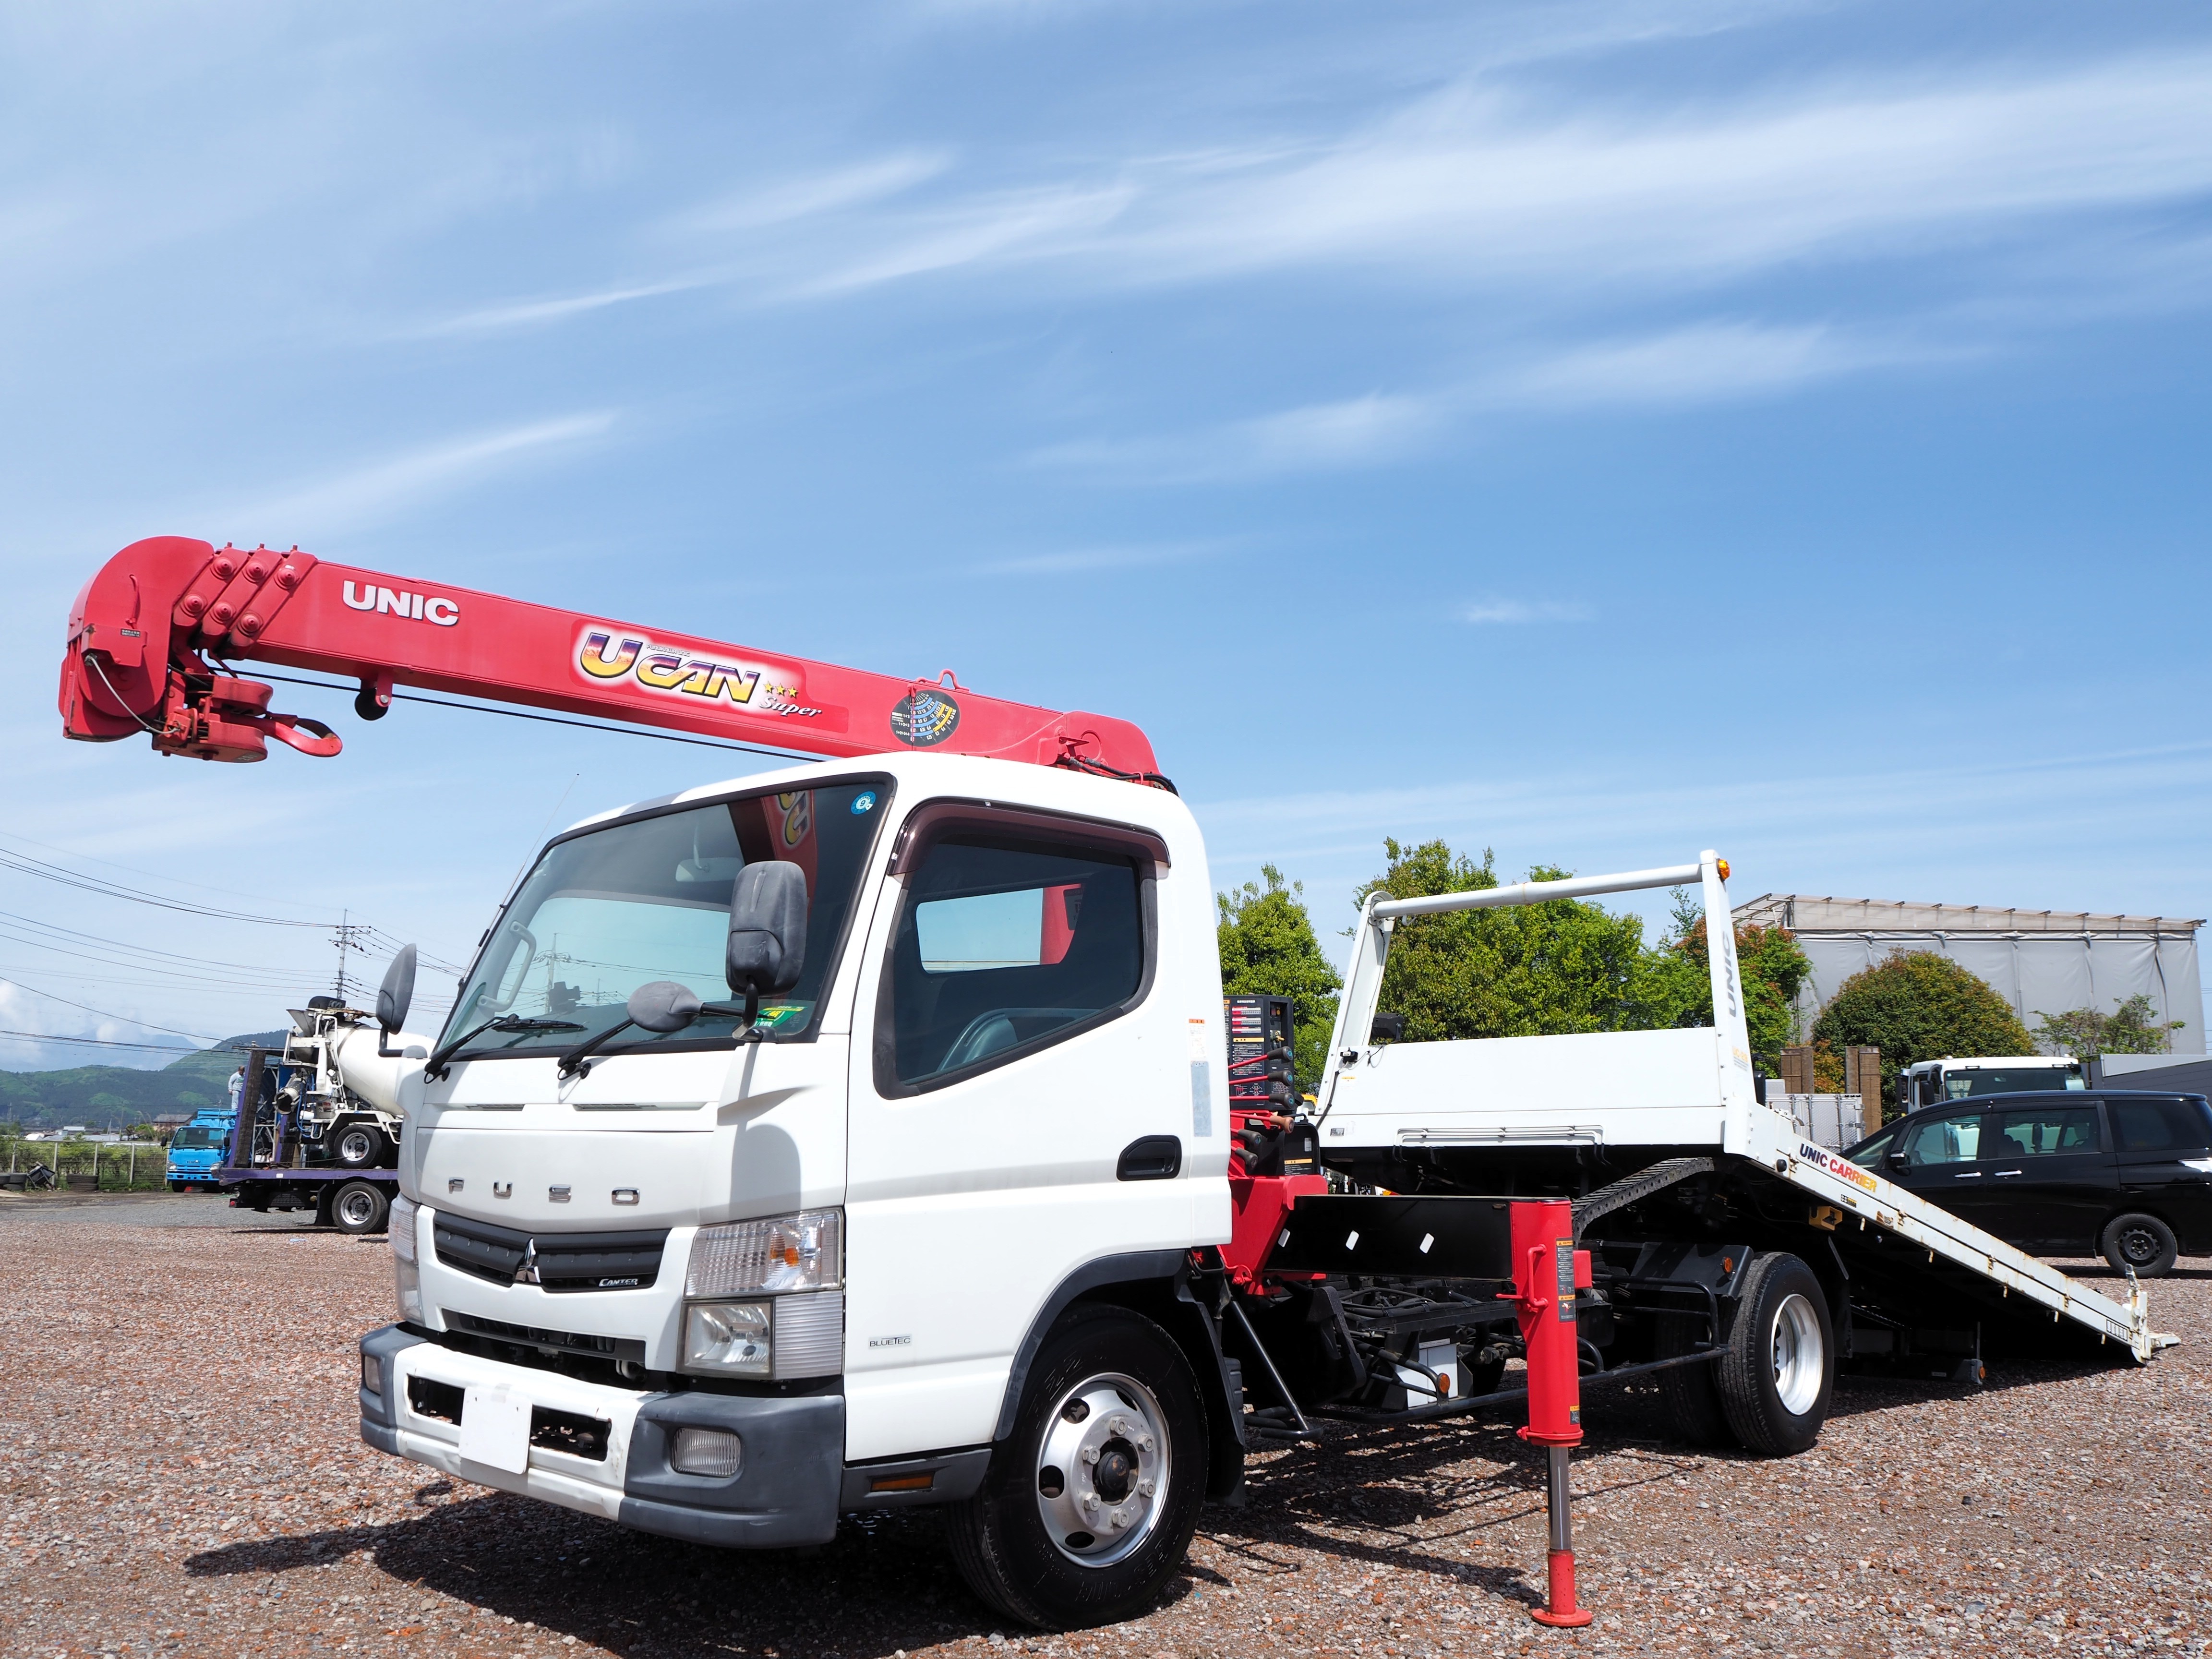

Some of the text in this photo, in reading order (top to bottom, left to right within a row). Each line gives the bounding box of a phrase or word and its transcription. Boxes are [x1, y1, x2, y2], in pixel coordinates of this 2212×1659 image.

[343, 580, 459, 626] UNIC
[580, 632, 760, 704] UCAN
[758, 697, 822, 717] Super
[1722, 931, 1736, 1017] UNIC
[448, 1177, 640, 1205] FUSO
[1800, 1143, 1877, 1193] UNIC CARRIER
[869, 1336, 911, 1347] BLUETEC
